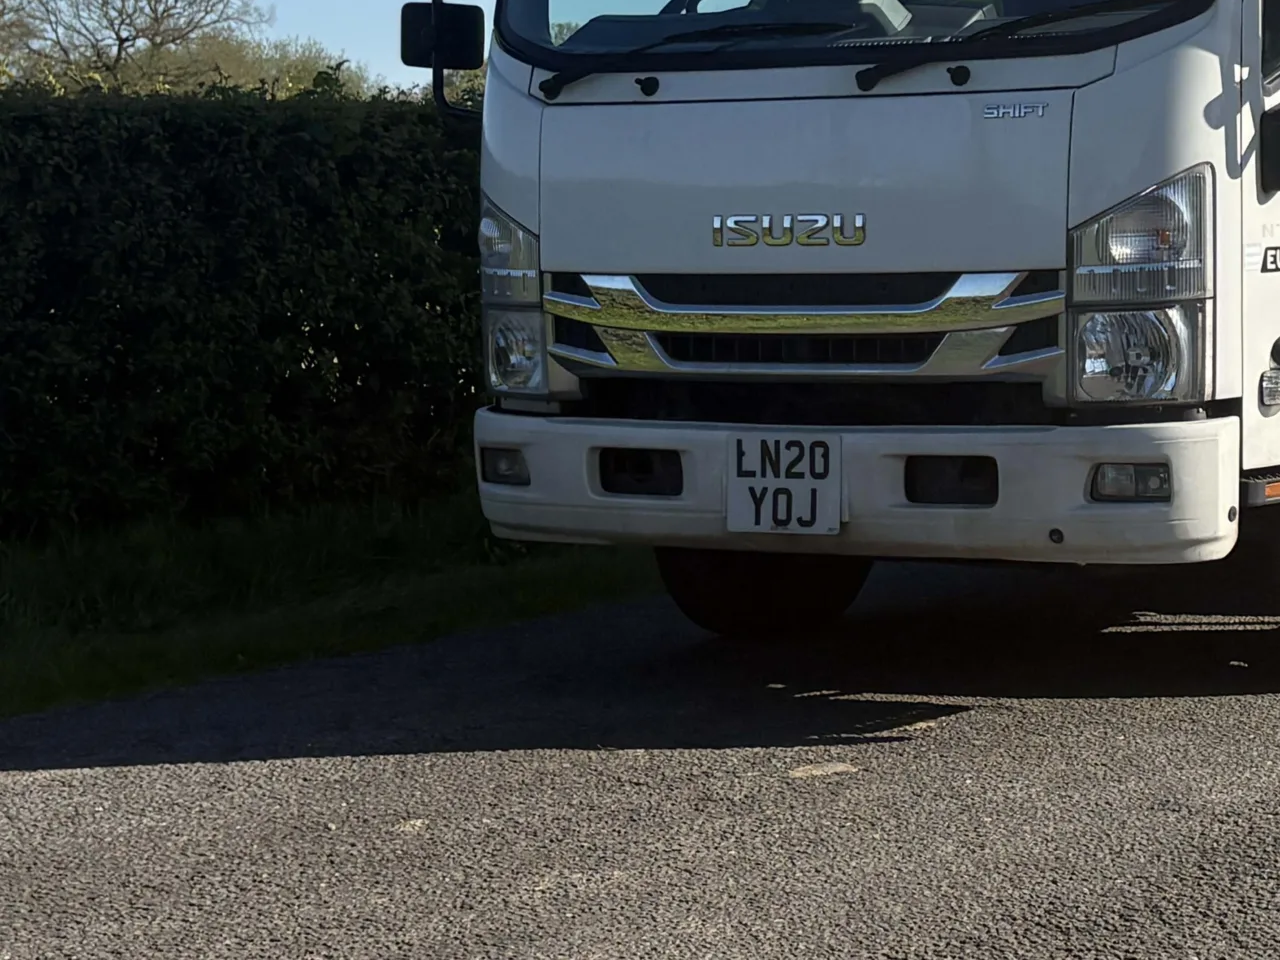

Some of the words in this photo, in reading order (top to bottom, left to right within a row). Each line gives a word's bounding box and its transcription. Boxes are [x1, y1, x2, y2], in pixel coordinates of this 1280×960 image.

[983, 102, 1049, 119] SHIFT
[712, 213, 867, 247] ISUZU
[736, 438, 830, 480] LN20
[747, 486, 818, 528] YOJ
